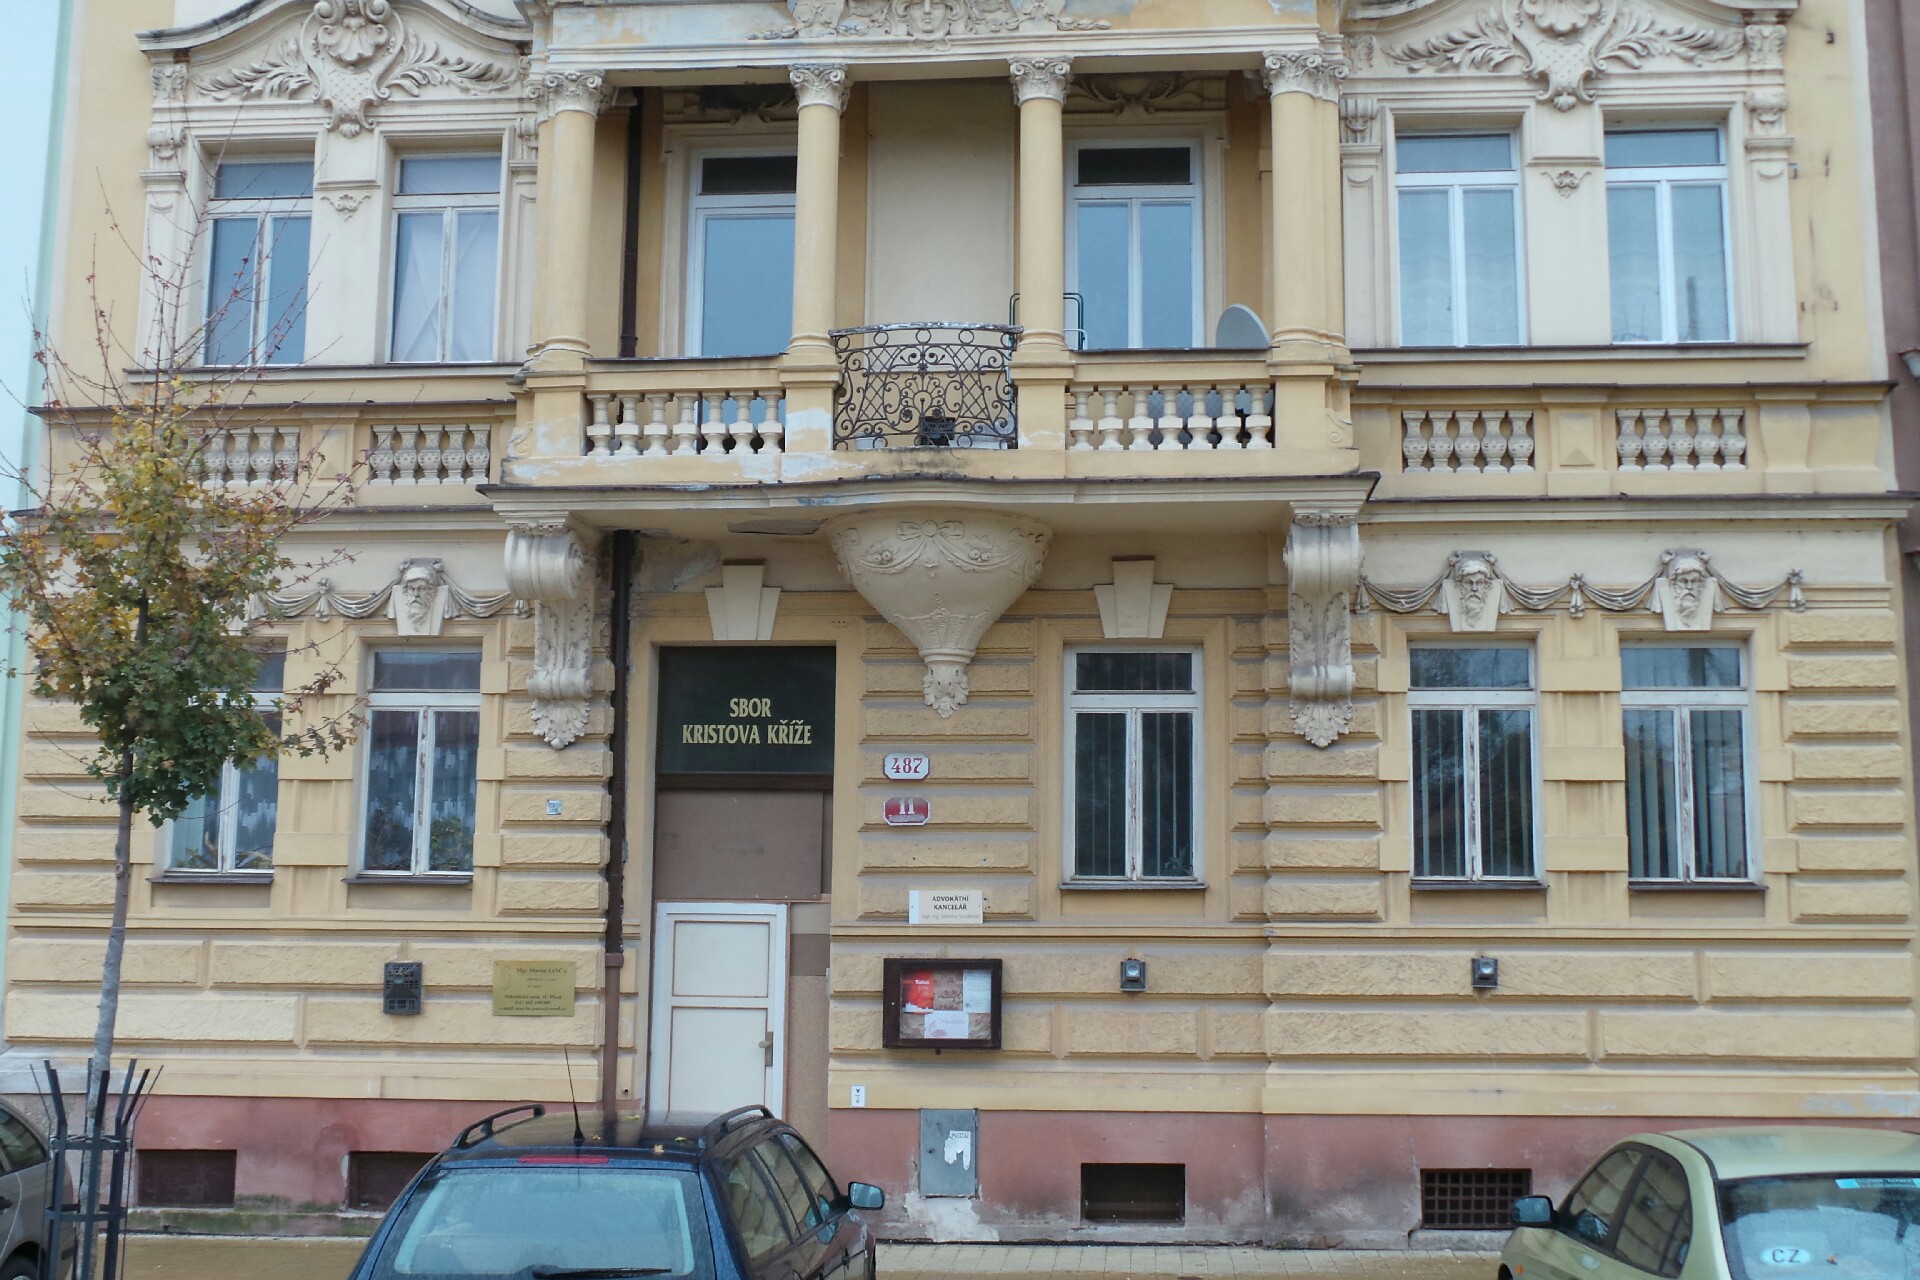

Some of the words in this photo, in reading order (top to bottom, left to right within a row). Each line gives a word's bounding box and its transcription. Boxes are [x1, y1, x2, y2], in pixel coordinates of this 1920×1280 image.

[730, 698, 771, 717] SBOR
[682, 724, 760, 744] KRISTOVA
[768, 719, 812, 744] KŘÍŽE
[891, 757, 922, 774] 487
[899, 798, 915, 815] 11
[1772, 1249, 1801, 1263] CZ
